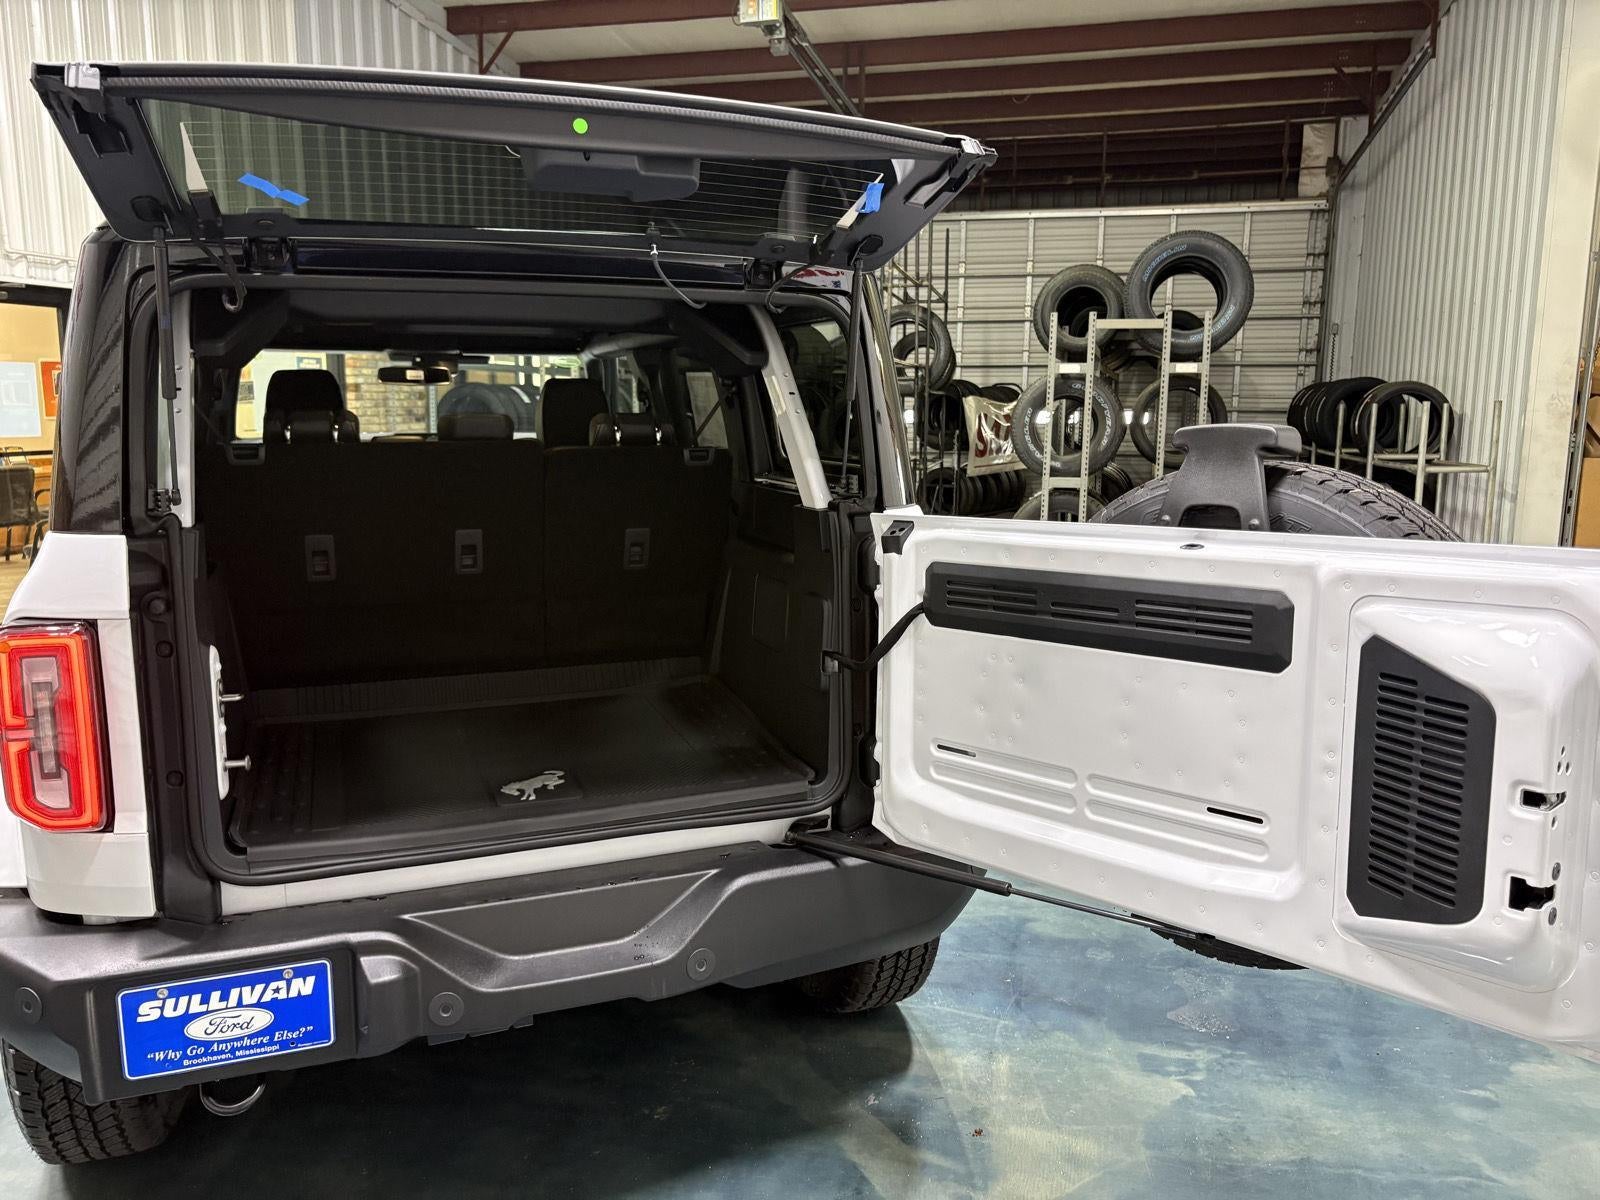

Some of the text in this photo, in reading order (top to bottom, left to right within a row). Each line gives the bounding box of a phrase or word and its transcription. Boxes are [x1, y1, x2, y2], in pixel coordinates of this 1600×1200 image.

[1024, 407, 1061, 467] WANGLER
[136, 976, 315, 1022] SULLIVAN
[204, 1014, 255, 1035] Ford
[183, 1044, 280, 1066] Brookhaven, Mississippi
[187, 1045, 205, 1056] Go
[208, 1036, 270, 1052] Anywhere
